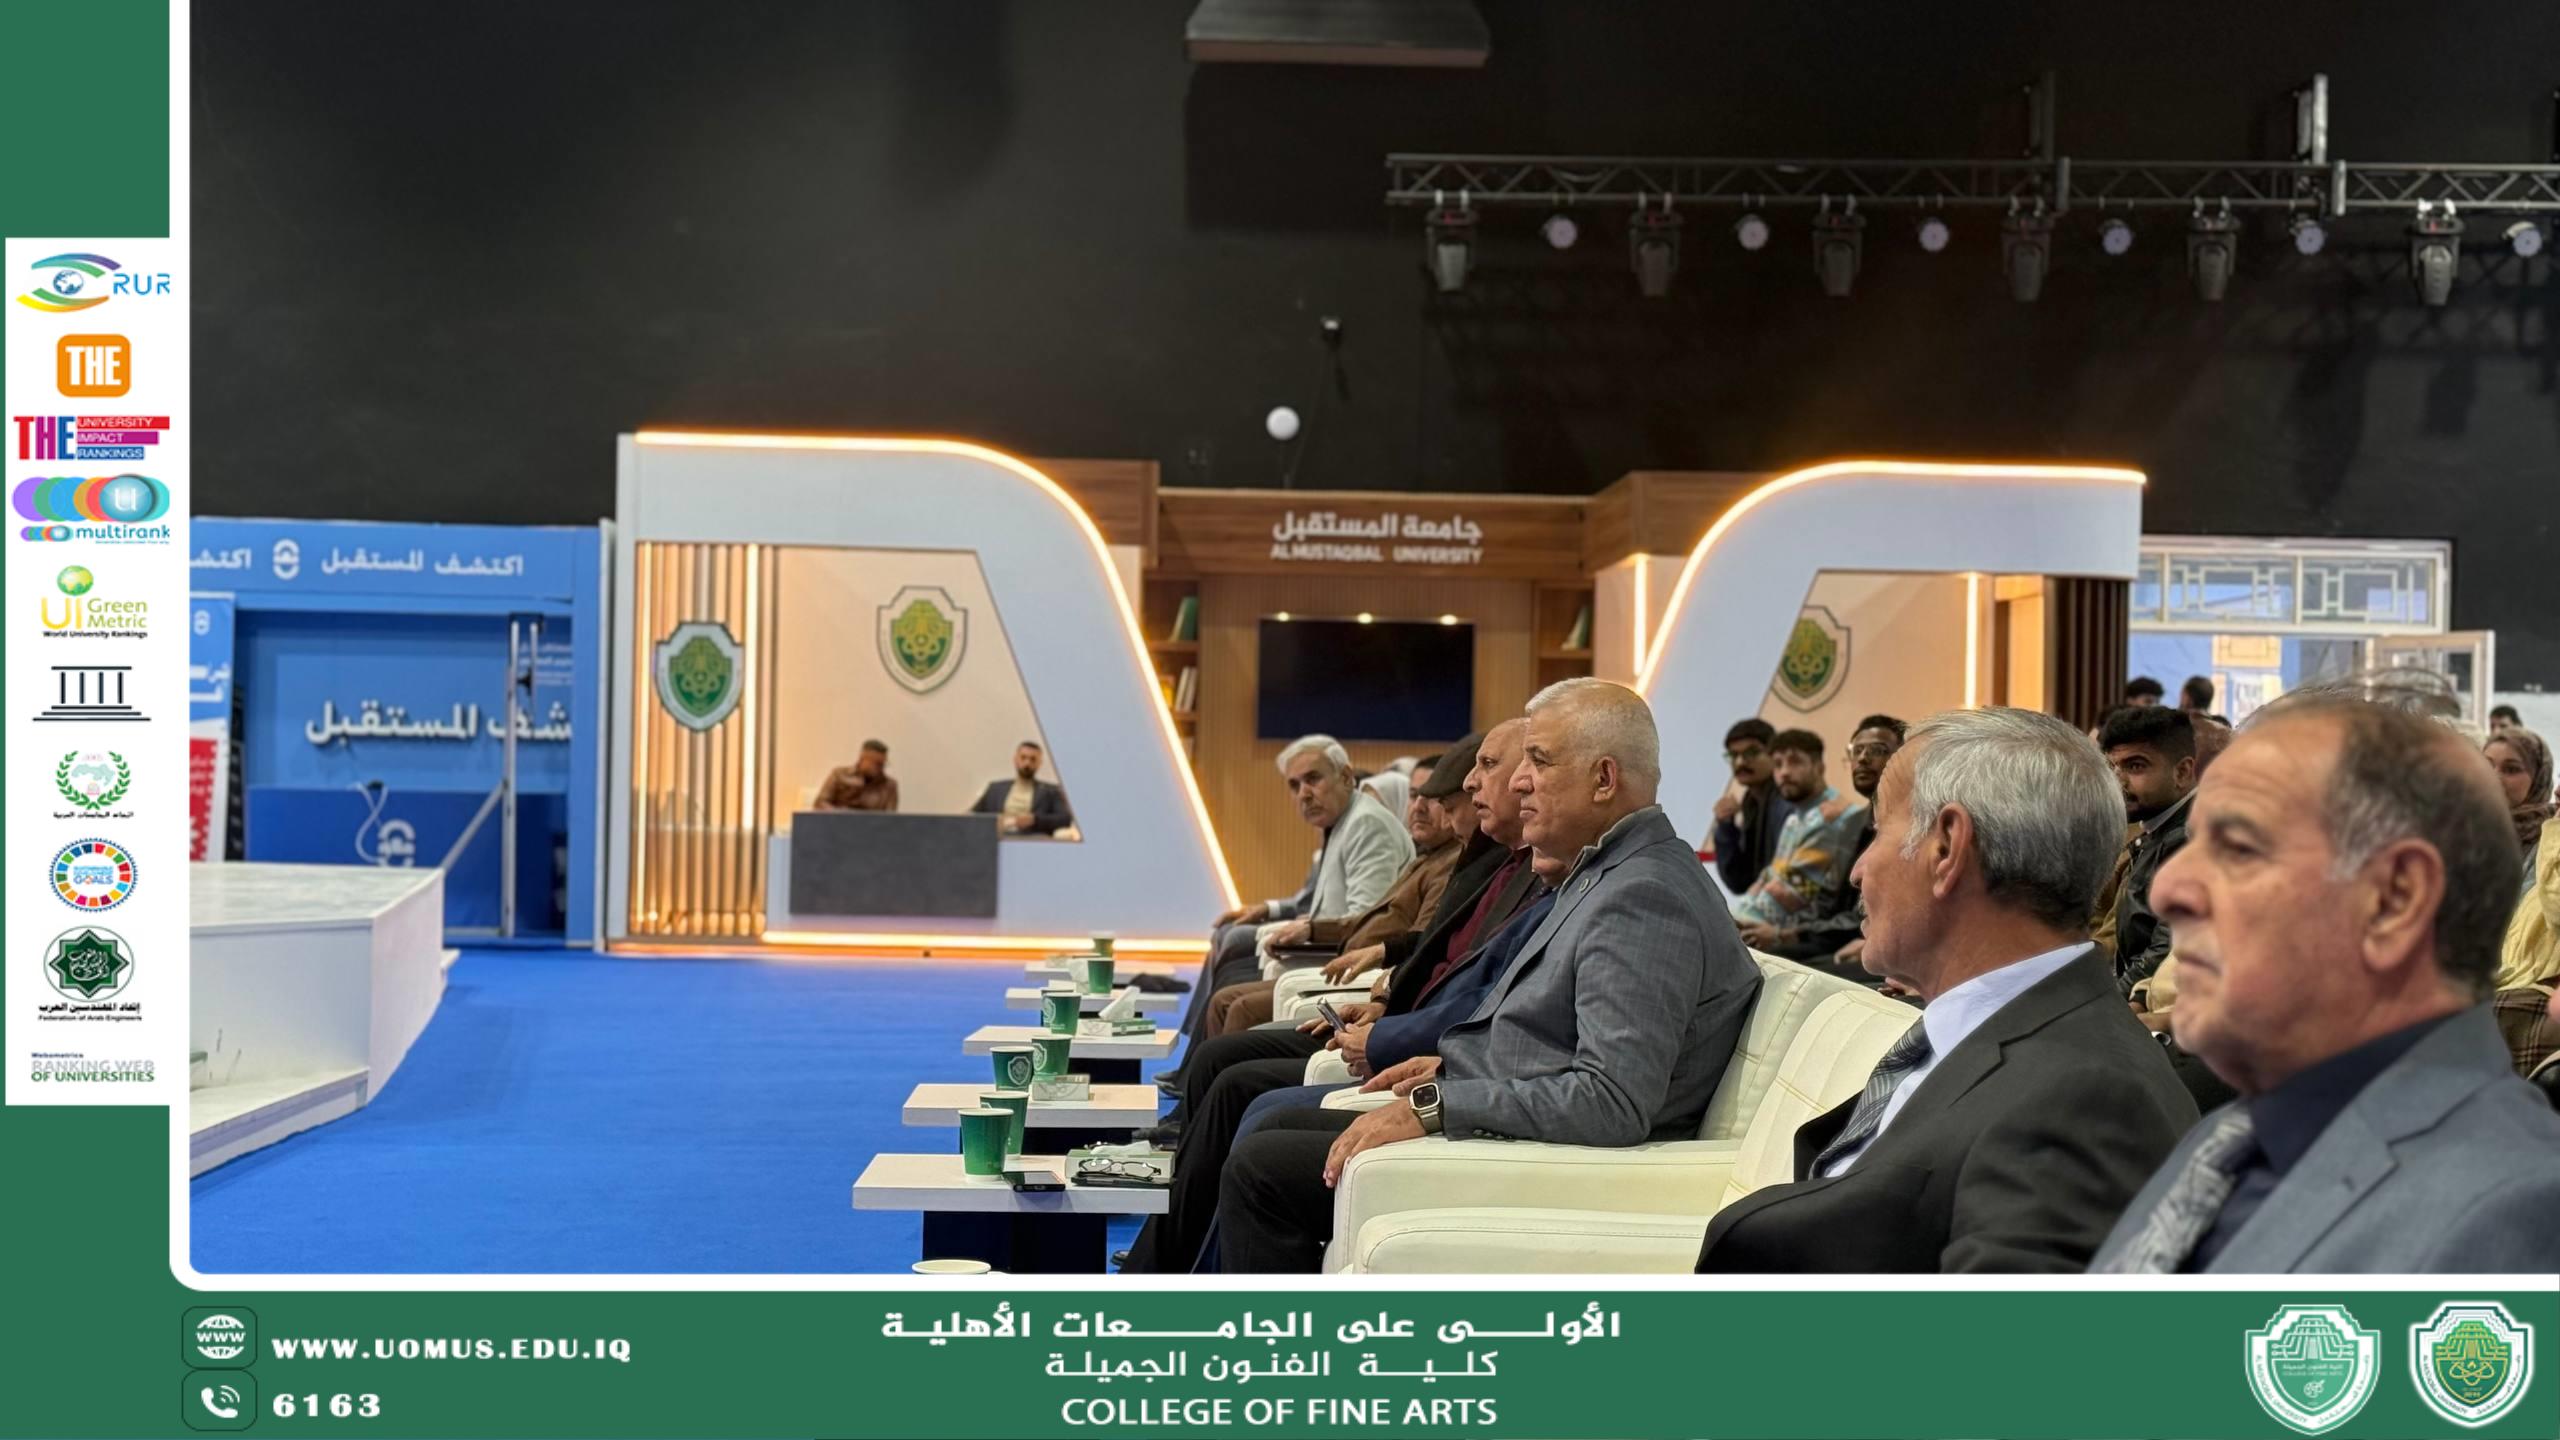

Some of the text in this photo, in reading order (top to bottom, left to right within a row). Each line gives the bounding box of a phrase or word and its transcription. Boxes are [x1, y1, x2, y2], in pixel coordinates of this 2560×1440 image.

[1272, 511, 1483, 545] جامعة المستقبل
[190, 548, 252, 569] اكتش
[322, 548, 523, 576] اكتشف المستقبل
[1392, 545, 1484, 565] UNIVERSITY
[305, 700, 478, 744] المستقبل
